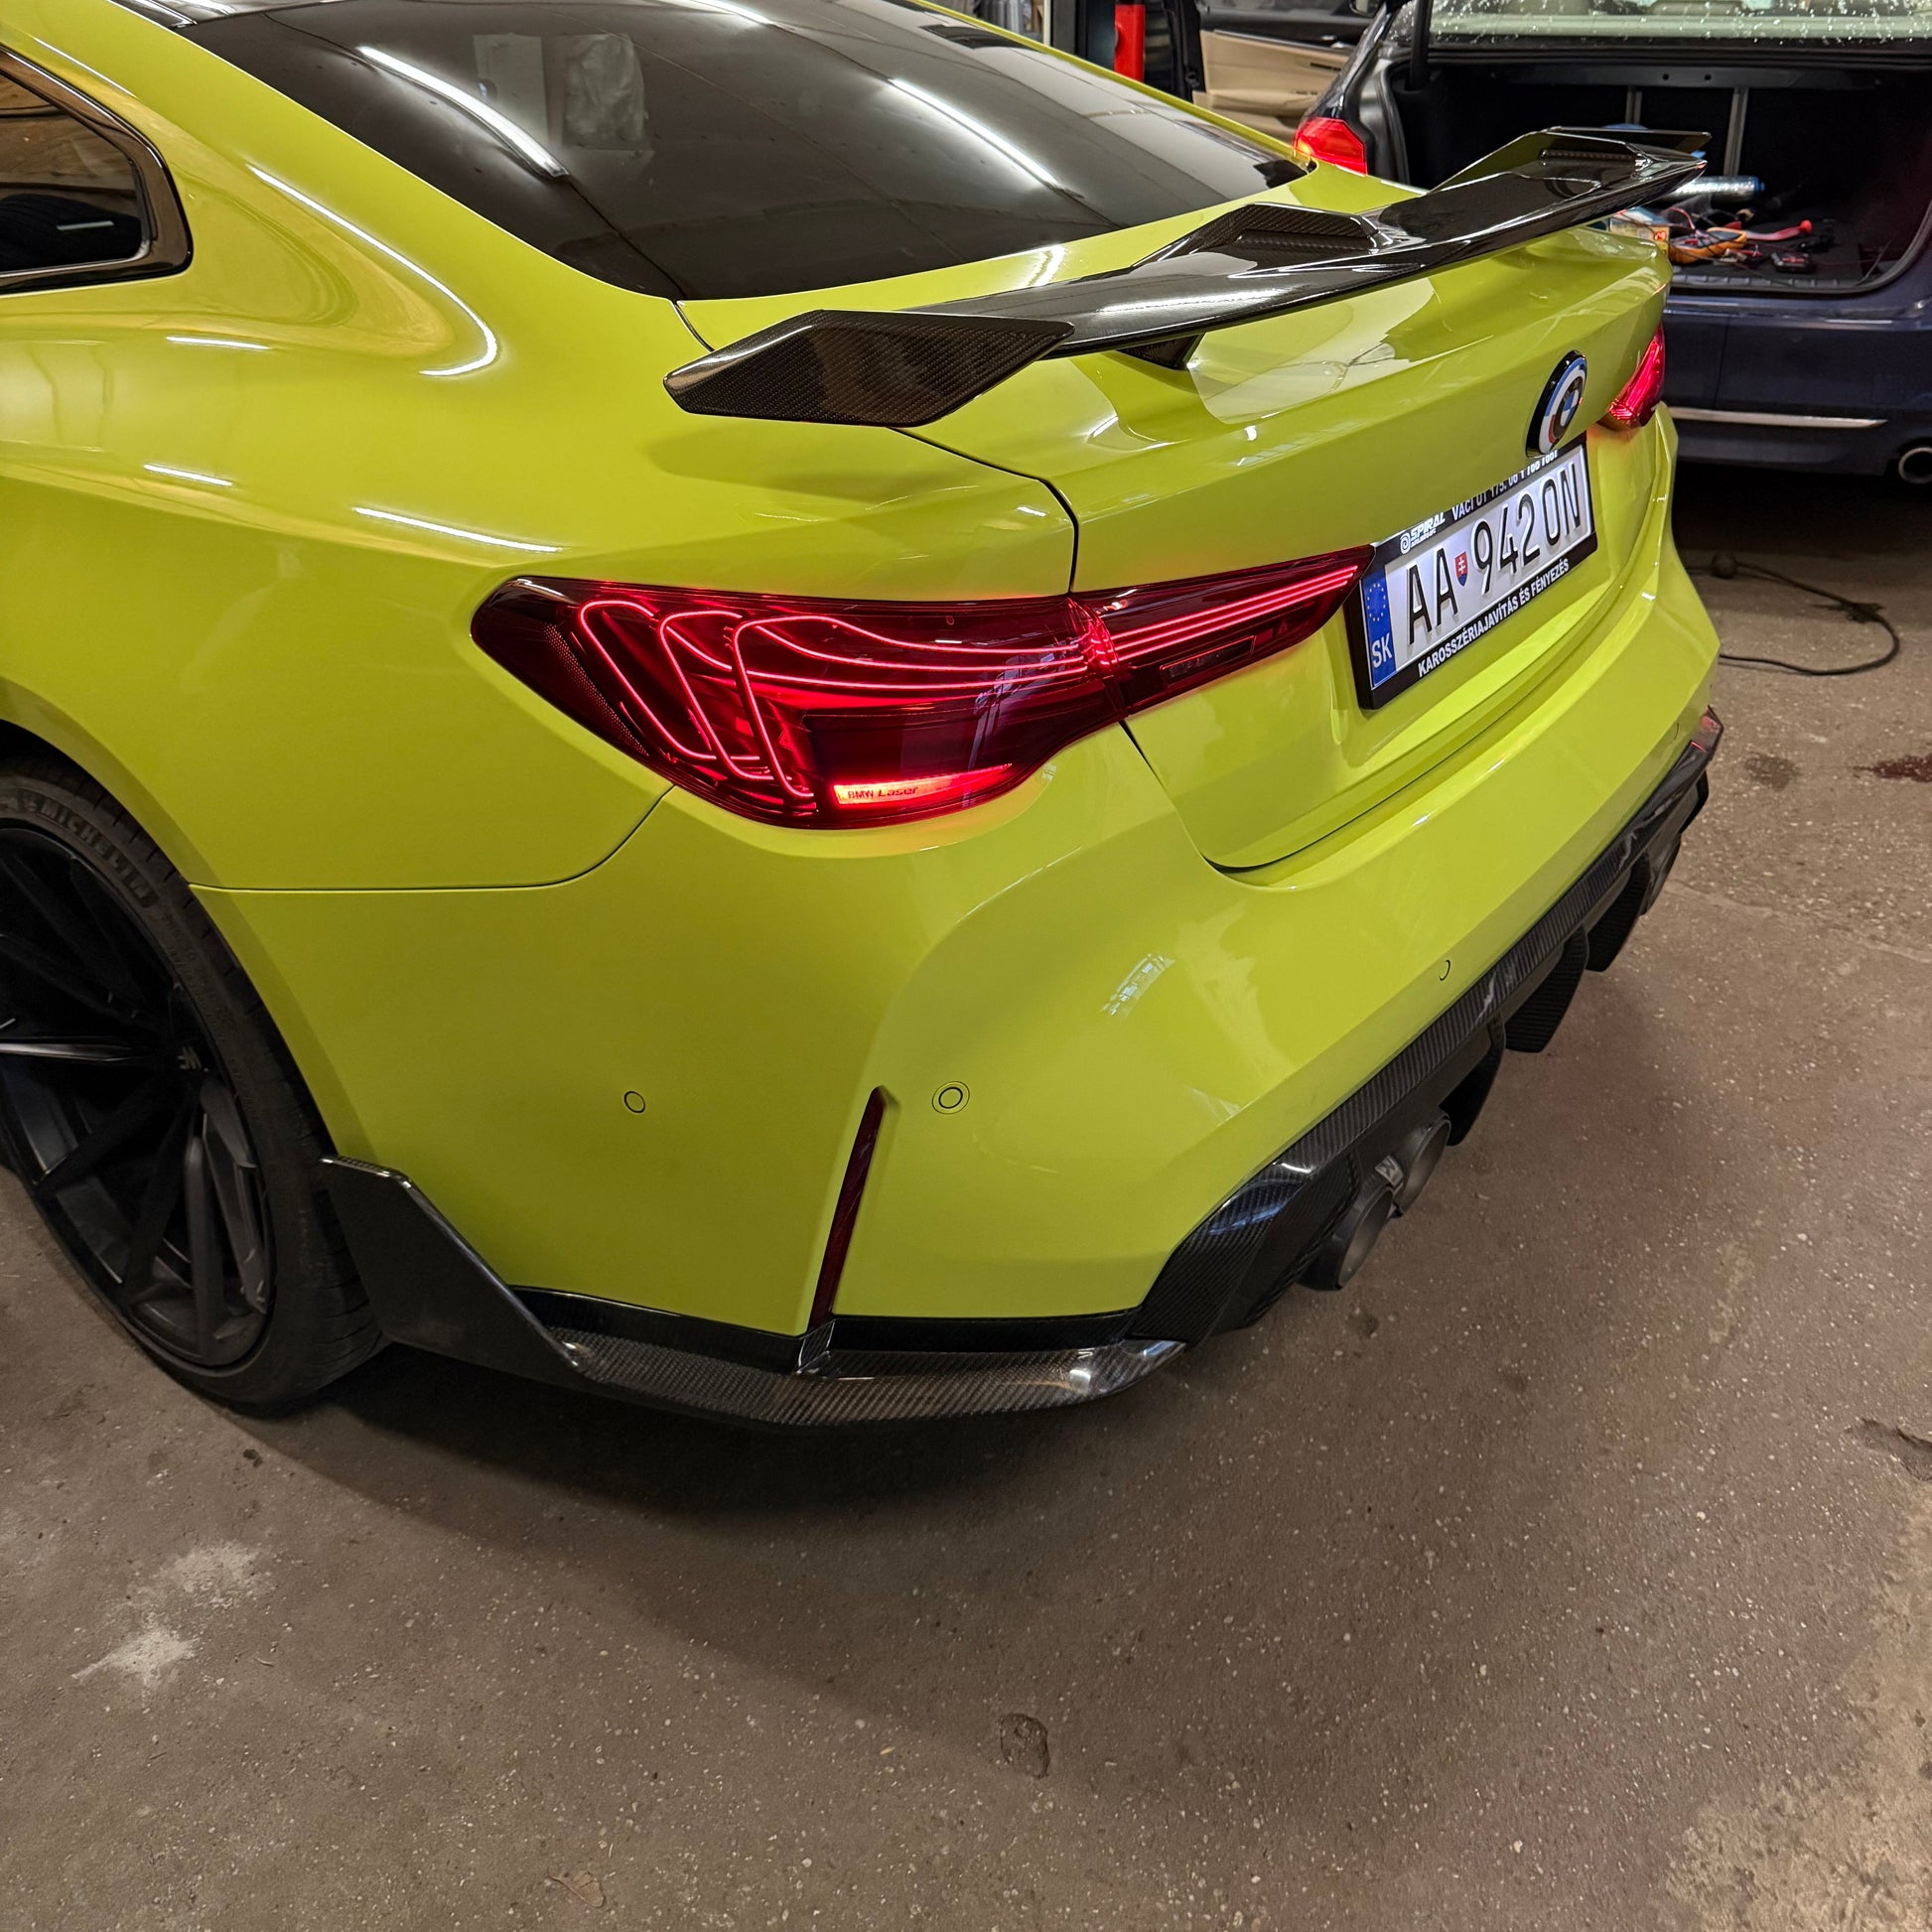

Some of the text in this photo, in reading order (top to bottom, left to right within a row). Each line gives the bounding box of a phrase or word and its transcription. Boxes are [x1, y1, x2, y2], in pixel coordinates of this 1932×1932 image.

[1410, 512, 1446, 539] SPIRAL
[1407, 546, 1459, 646] AA
[1417, 557, 1571, 678] KAROSSZÉRIAJAVÍTÁS ÉS FÉNYEZÉS
[1372, 631, 1393, 668] SK
[848, 787, 918, 799] BMW Laser
[42, 801, 150, 899] MICHELIN
